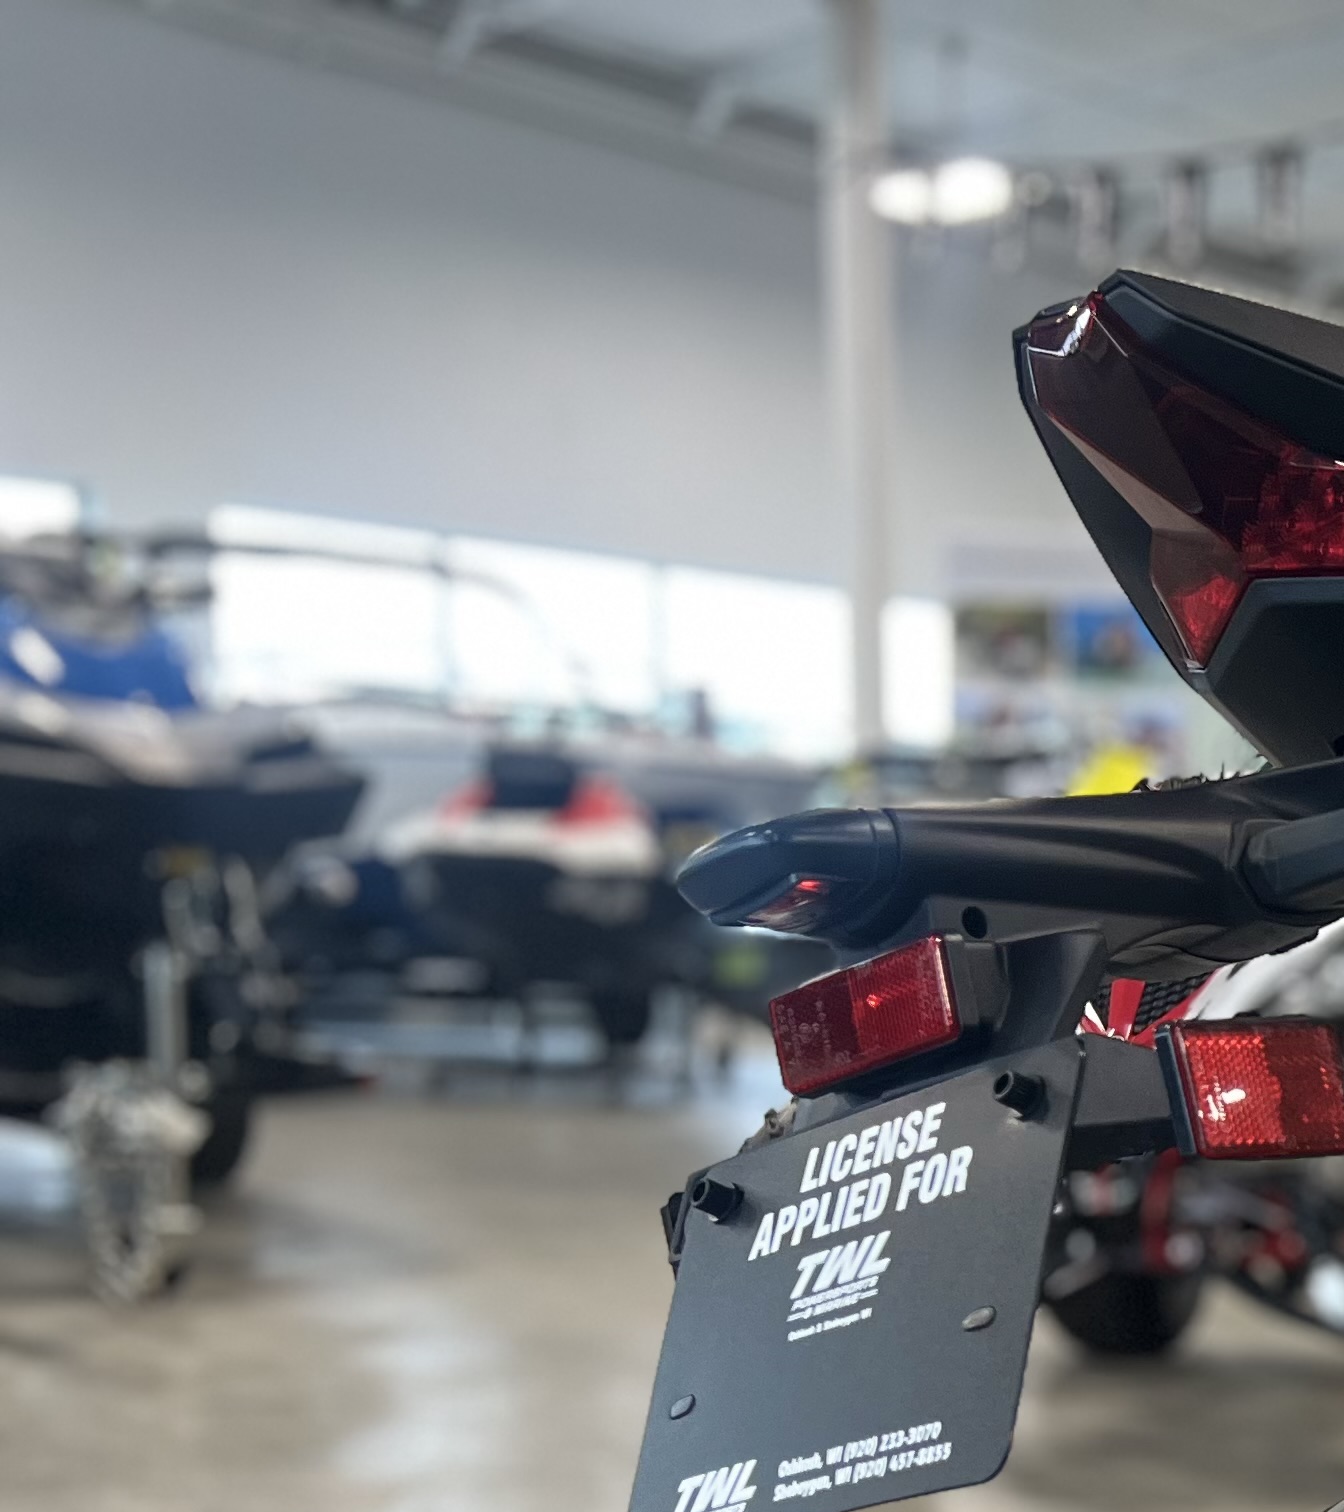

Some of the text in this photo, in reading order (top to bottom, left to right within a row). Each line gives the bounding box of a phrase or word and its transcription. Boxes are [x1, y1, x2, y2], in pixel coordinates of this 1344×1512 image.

[799, 1102, 946, 1193] LICENSE
[748, 1145, 974, 1261] APPLIED FOR
[789, 1230, 892, 1300] TWL
